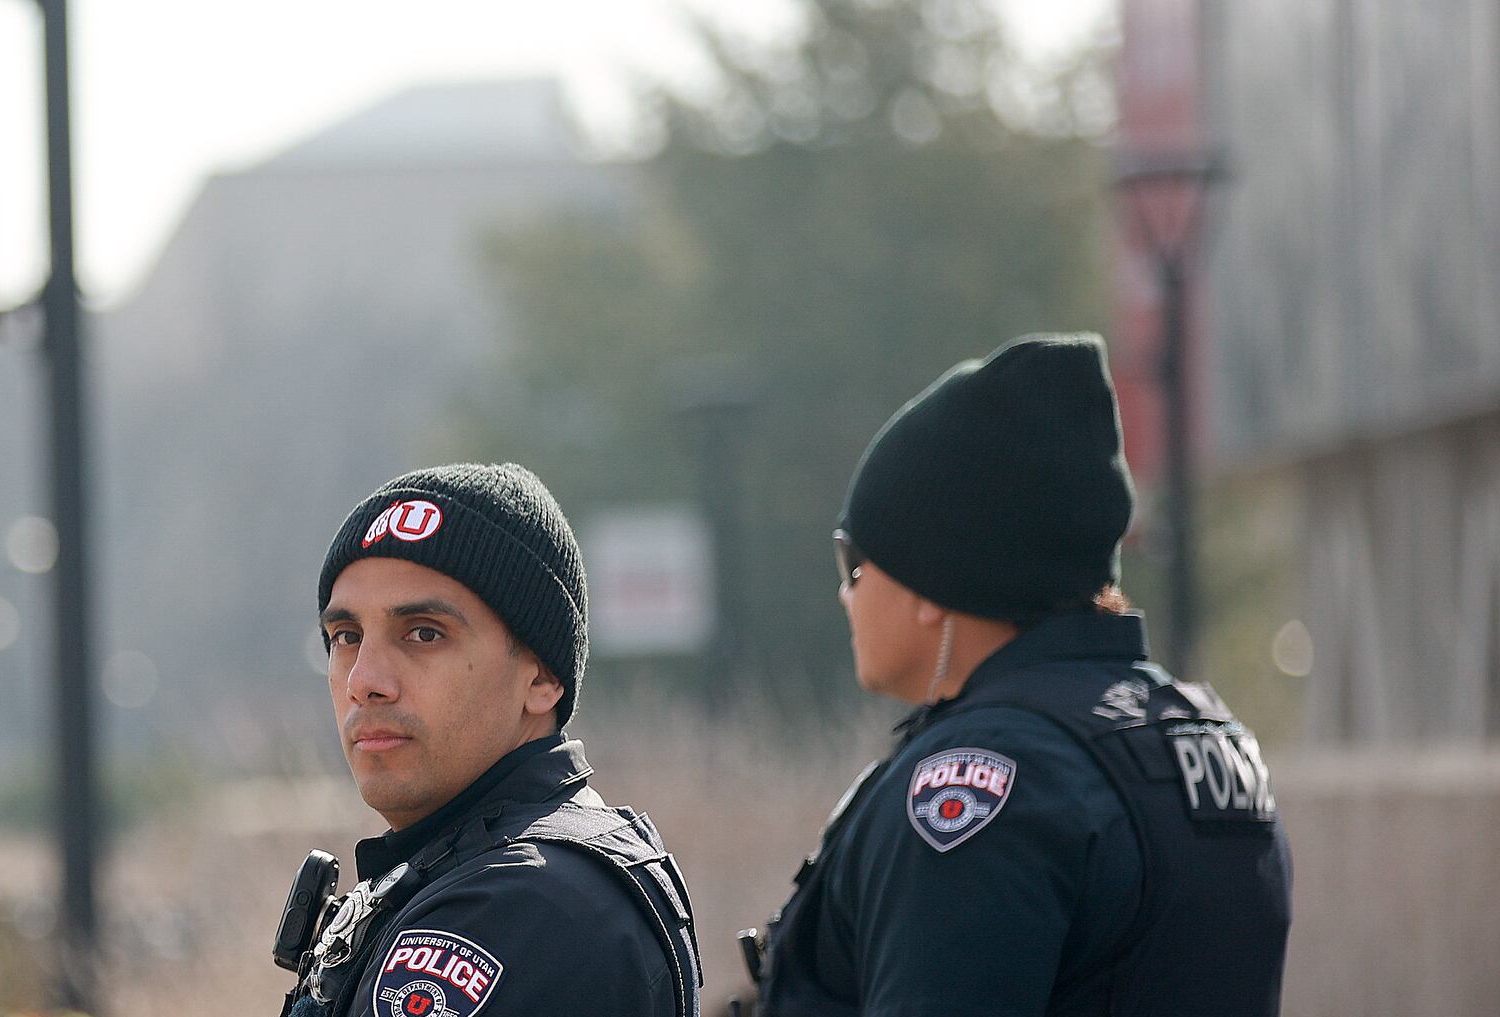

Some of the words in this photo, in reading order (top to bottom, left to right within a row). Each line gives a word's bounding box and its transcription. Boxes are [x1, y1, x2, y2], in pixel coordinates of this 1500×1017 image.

[397, 504, 437, 535] U
[913, 763, 1008, 797] POLICE
[400, 937, 460, 952] UNIVERSITY
[459, 947, 473, 958] OF
[472, 954, 495, 978] UTAH
[384, 947, 489, 1003] POLICE
[380, 990, 395, 999] EST.
[407, 993, 432, 1015] U
